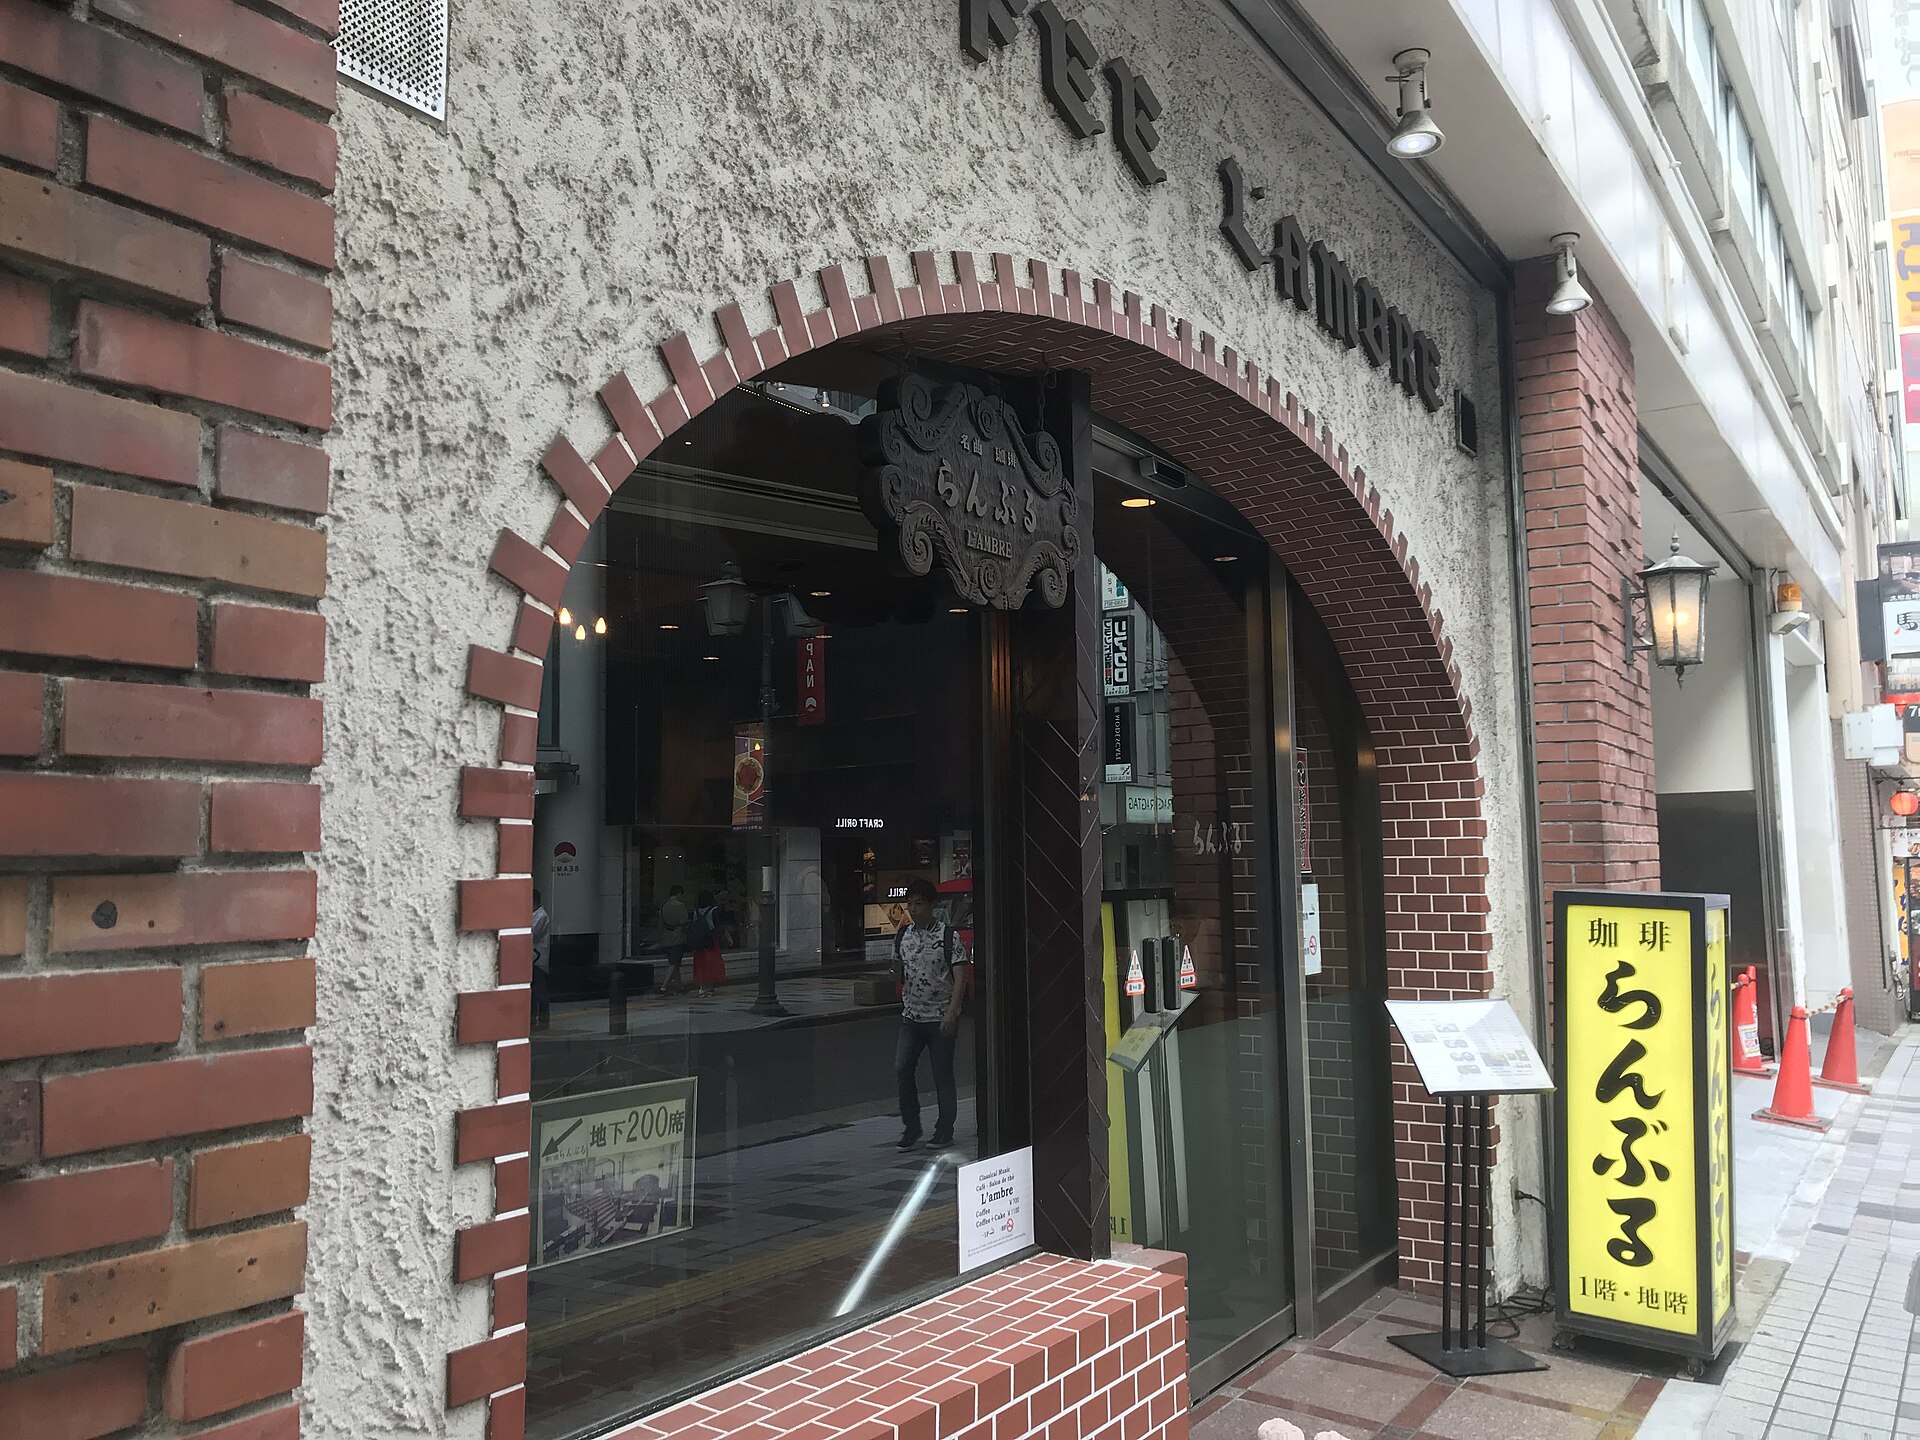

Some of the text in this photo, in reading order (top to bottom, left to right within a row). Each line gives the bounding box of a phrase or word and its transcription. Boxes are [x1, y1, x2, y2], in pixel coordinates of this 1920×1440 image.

[959, 433, 1017, 469] 名曲 珈琲
[937, 458, 1038, 534] らんぶる
[965, 530, 1013, 560] L'AMBRE
[1588, 917, 1672, 953] 珈琲
[589, 1105, 685, 1148] 地下200席
[1592, 960, 1672, 1268] らんぶる
[978, 1167, 1011, 1182] Classical Music
[989, 1178, 1001, 1188] Salon
[1001, 1176, 1007, 1185] de
[981, 1186, 1014, 1204] L'ambre
[976, 1208, 991, 1218] Coffee
